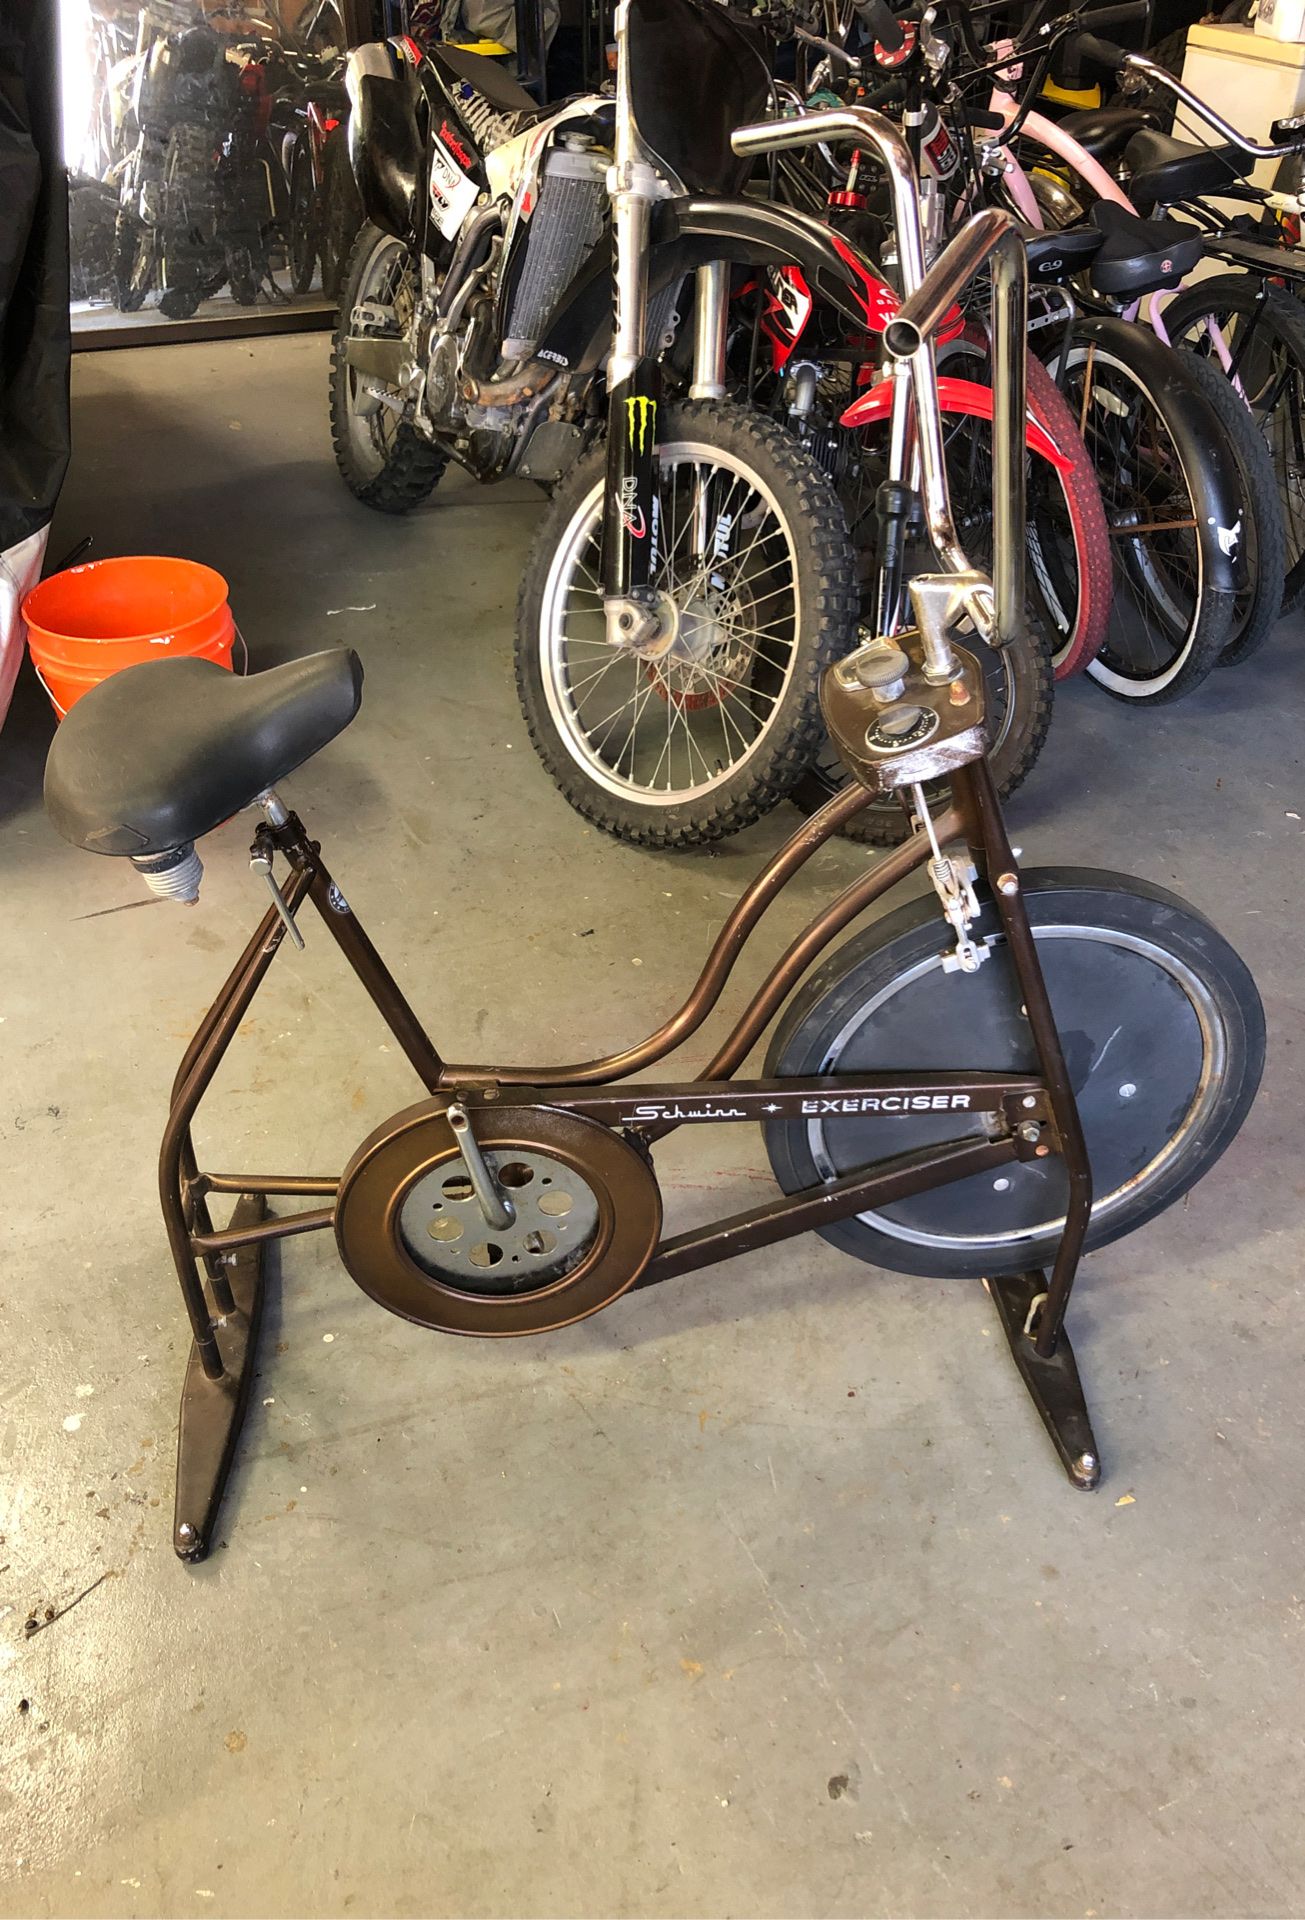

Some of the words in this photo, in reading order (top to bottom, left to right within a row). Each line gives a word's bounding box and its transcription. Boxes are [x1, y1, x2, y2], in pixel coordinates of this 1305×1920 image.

[621, 476, 638, 528] DNA
[621, 1103, 747, 1121] Schwinn
[801, 1094, 971, 1114] EXERCISER
